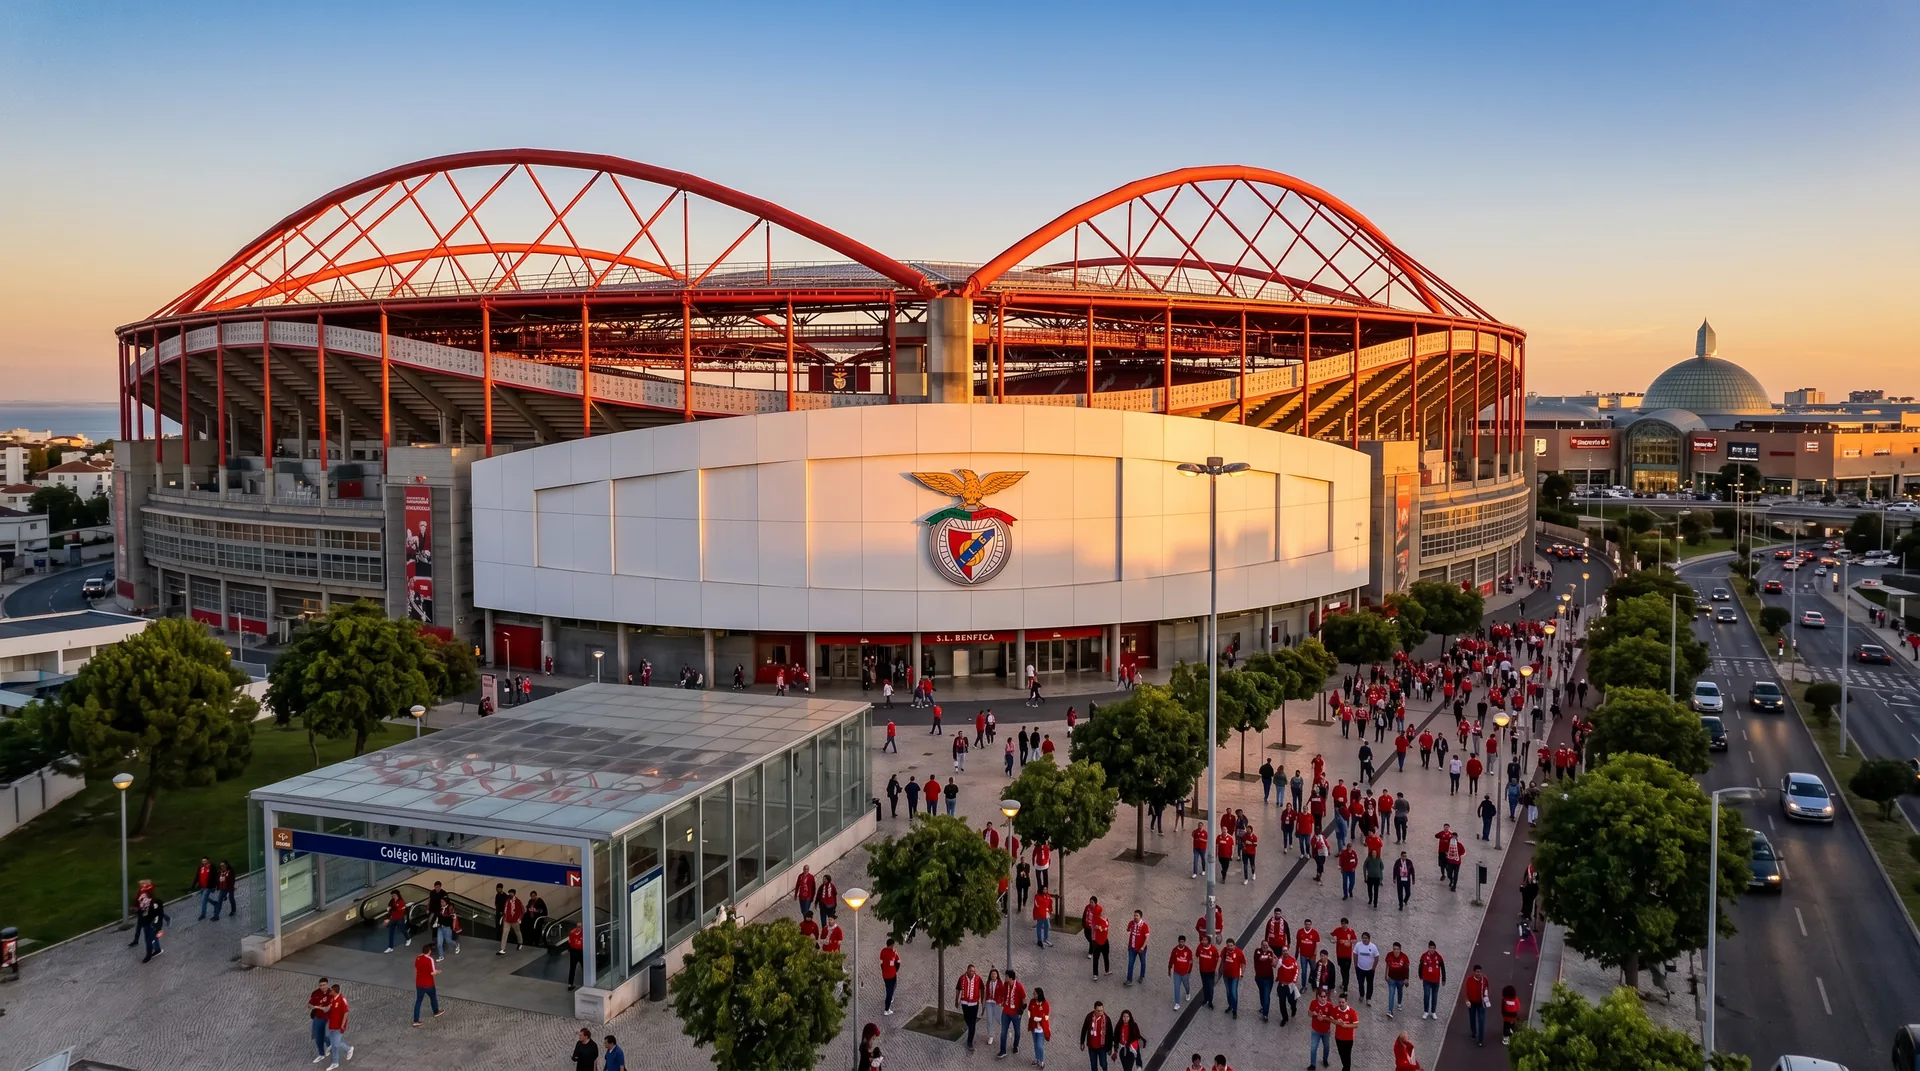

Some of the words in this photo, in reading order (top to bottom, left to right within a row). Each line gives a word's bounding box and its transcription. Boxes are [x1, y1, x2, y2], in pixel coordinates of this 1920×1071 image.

[955, 633, 995, 641] BENFICA
[380, 846, 418, 863] Colégio
[421, 851, 476, 869] Militar/Luz
